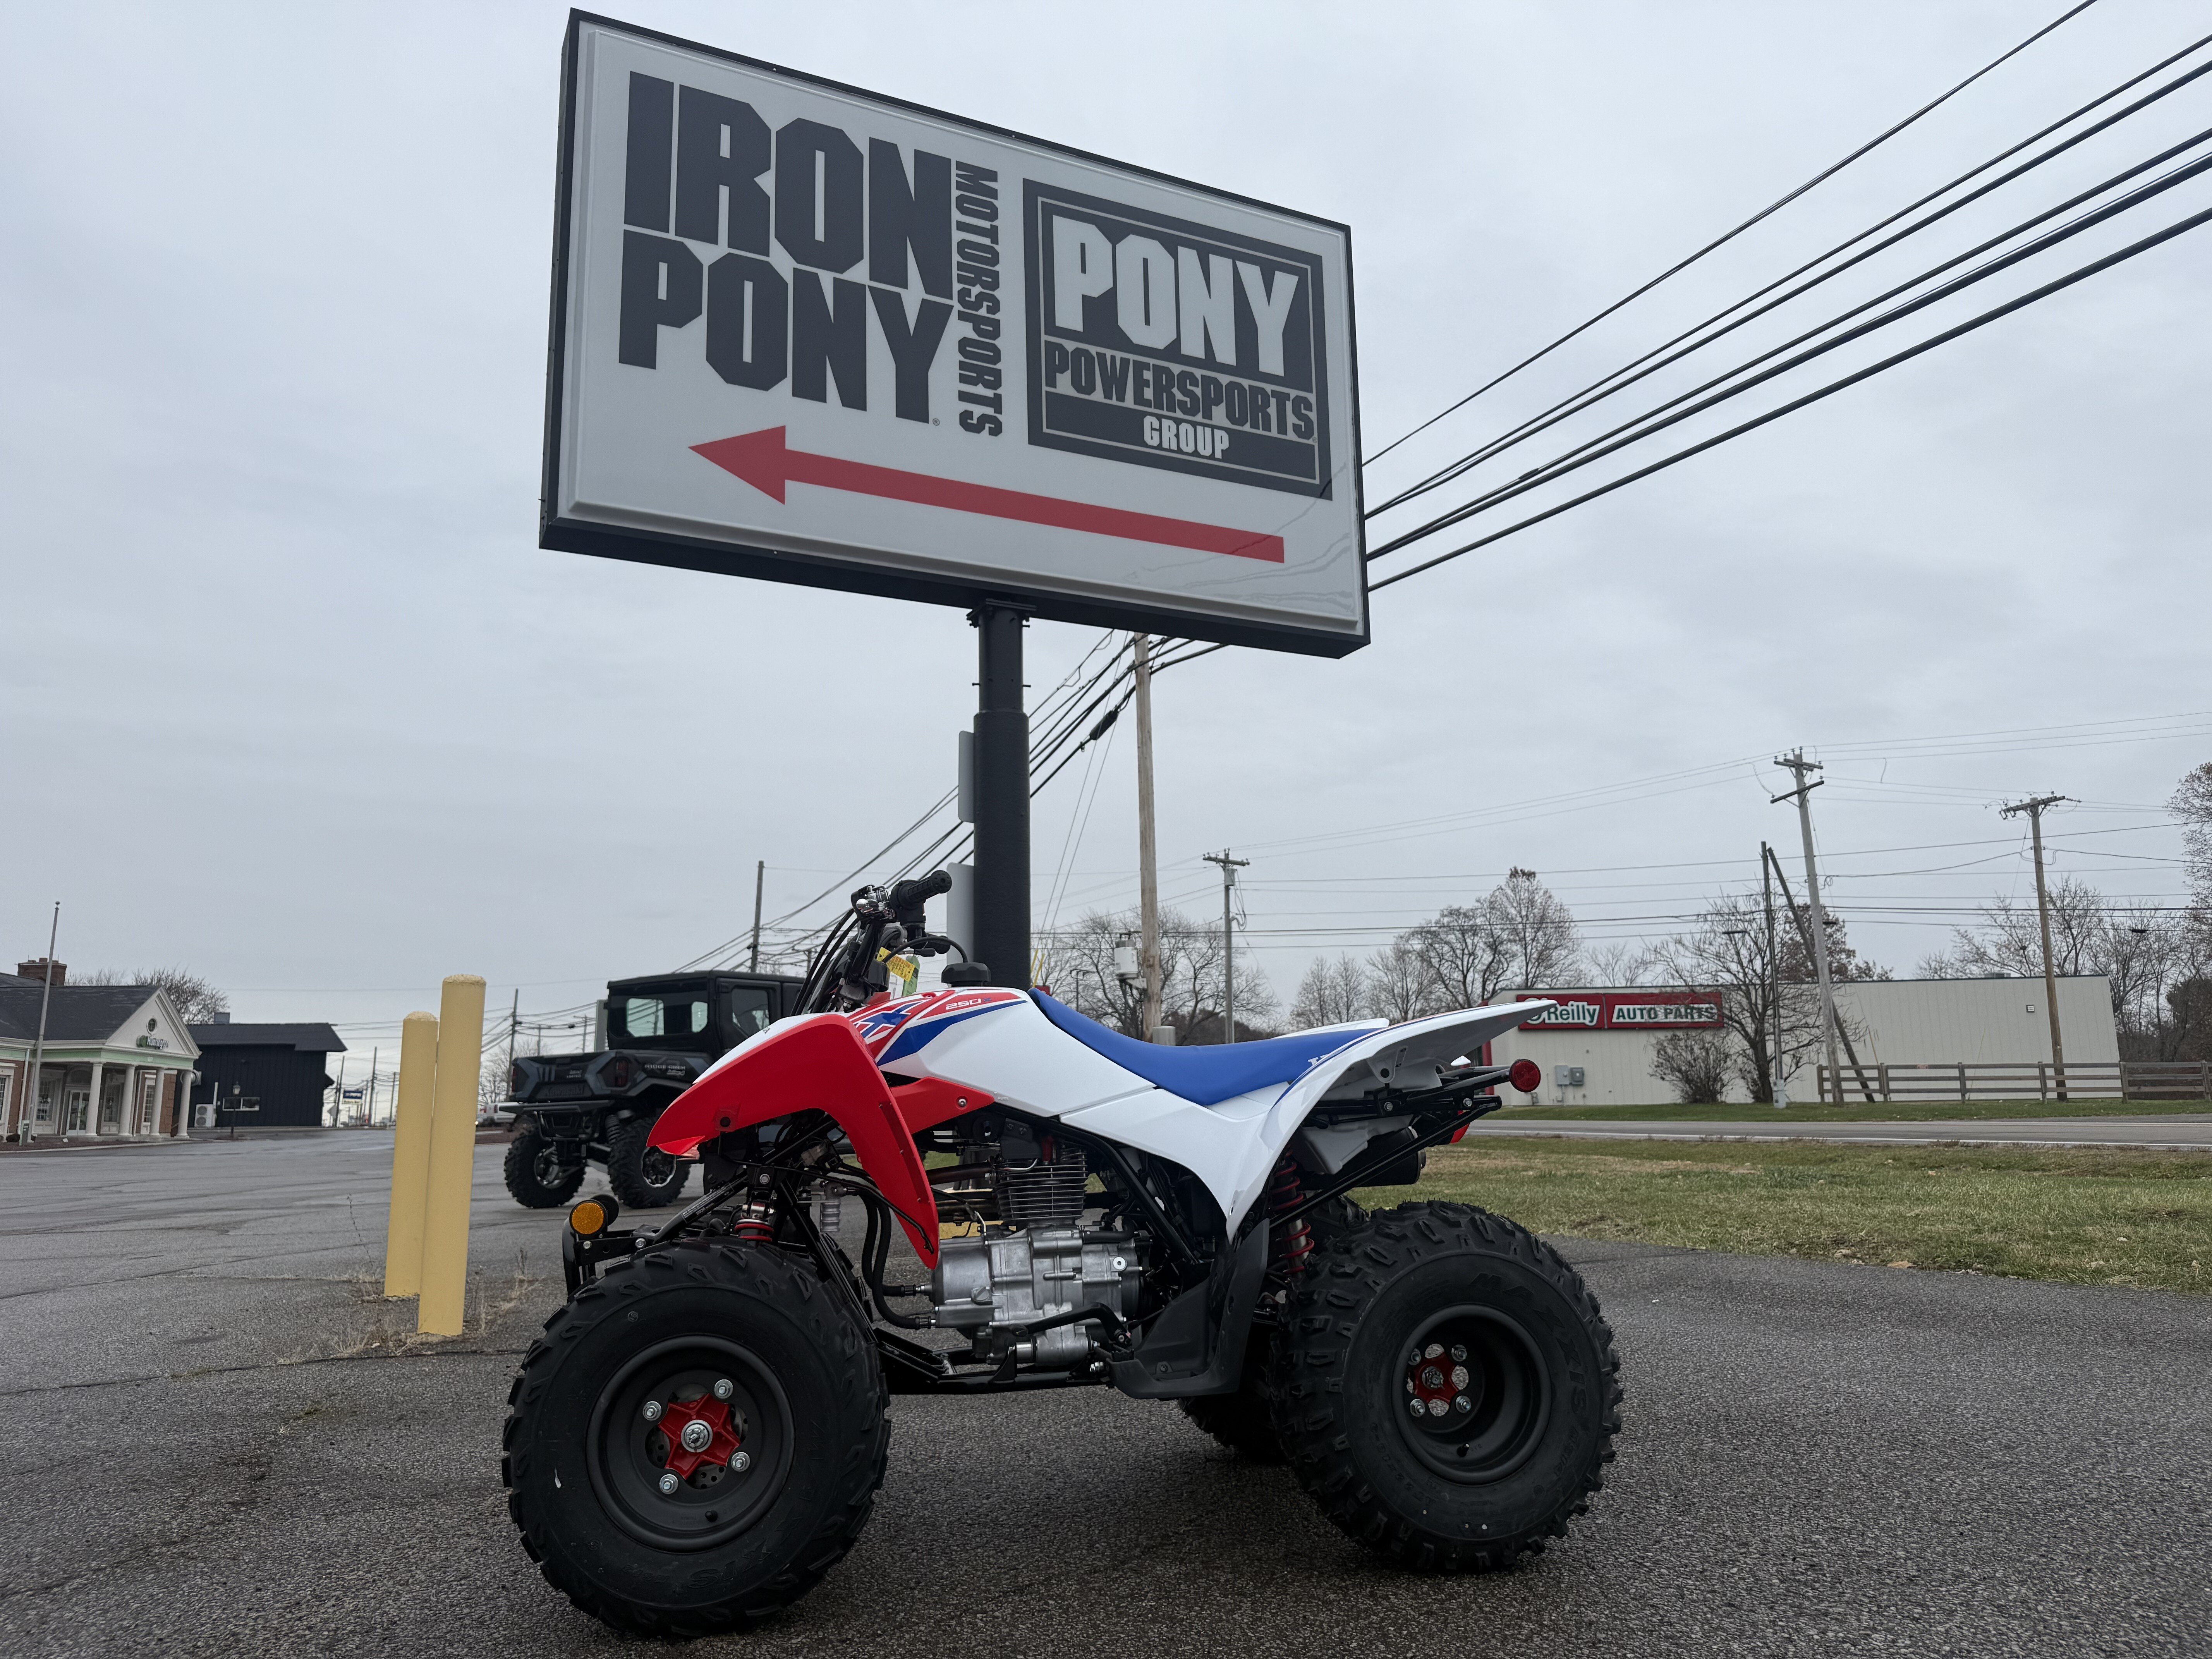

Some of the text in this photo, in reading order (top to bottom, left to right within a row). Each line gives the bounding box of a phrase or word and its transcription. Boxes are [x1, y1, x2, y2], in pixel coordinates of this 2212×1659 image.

[623, 71, 953, 300] IRON
[618, 229, 954, 424] PONY
[955, 160, 1003, 438] MOTORSPORTS
[1052, 215, 1300, 377] PONY
[1045, 342, 1314, 440] POWERSPORTS
[1143, 415, 1230, 459] GROUP
[1530, 1003, 1715, 1023] Reilly AUTO PARTS
[1468, 1272, 1588, 1416] MAXXIS
